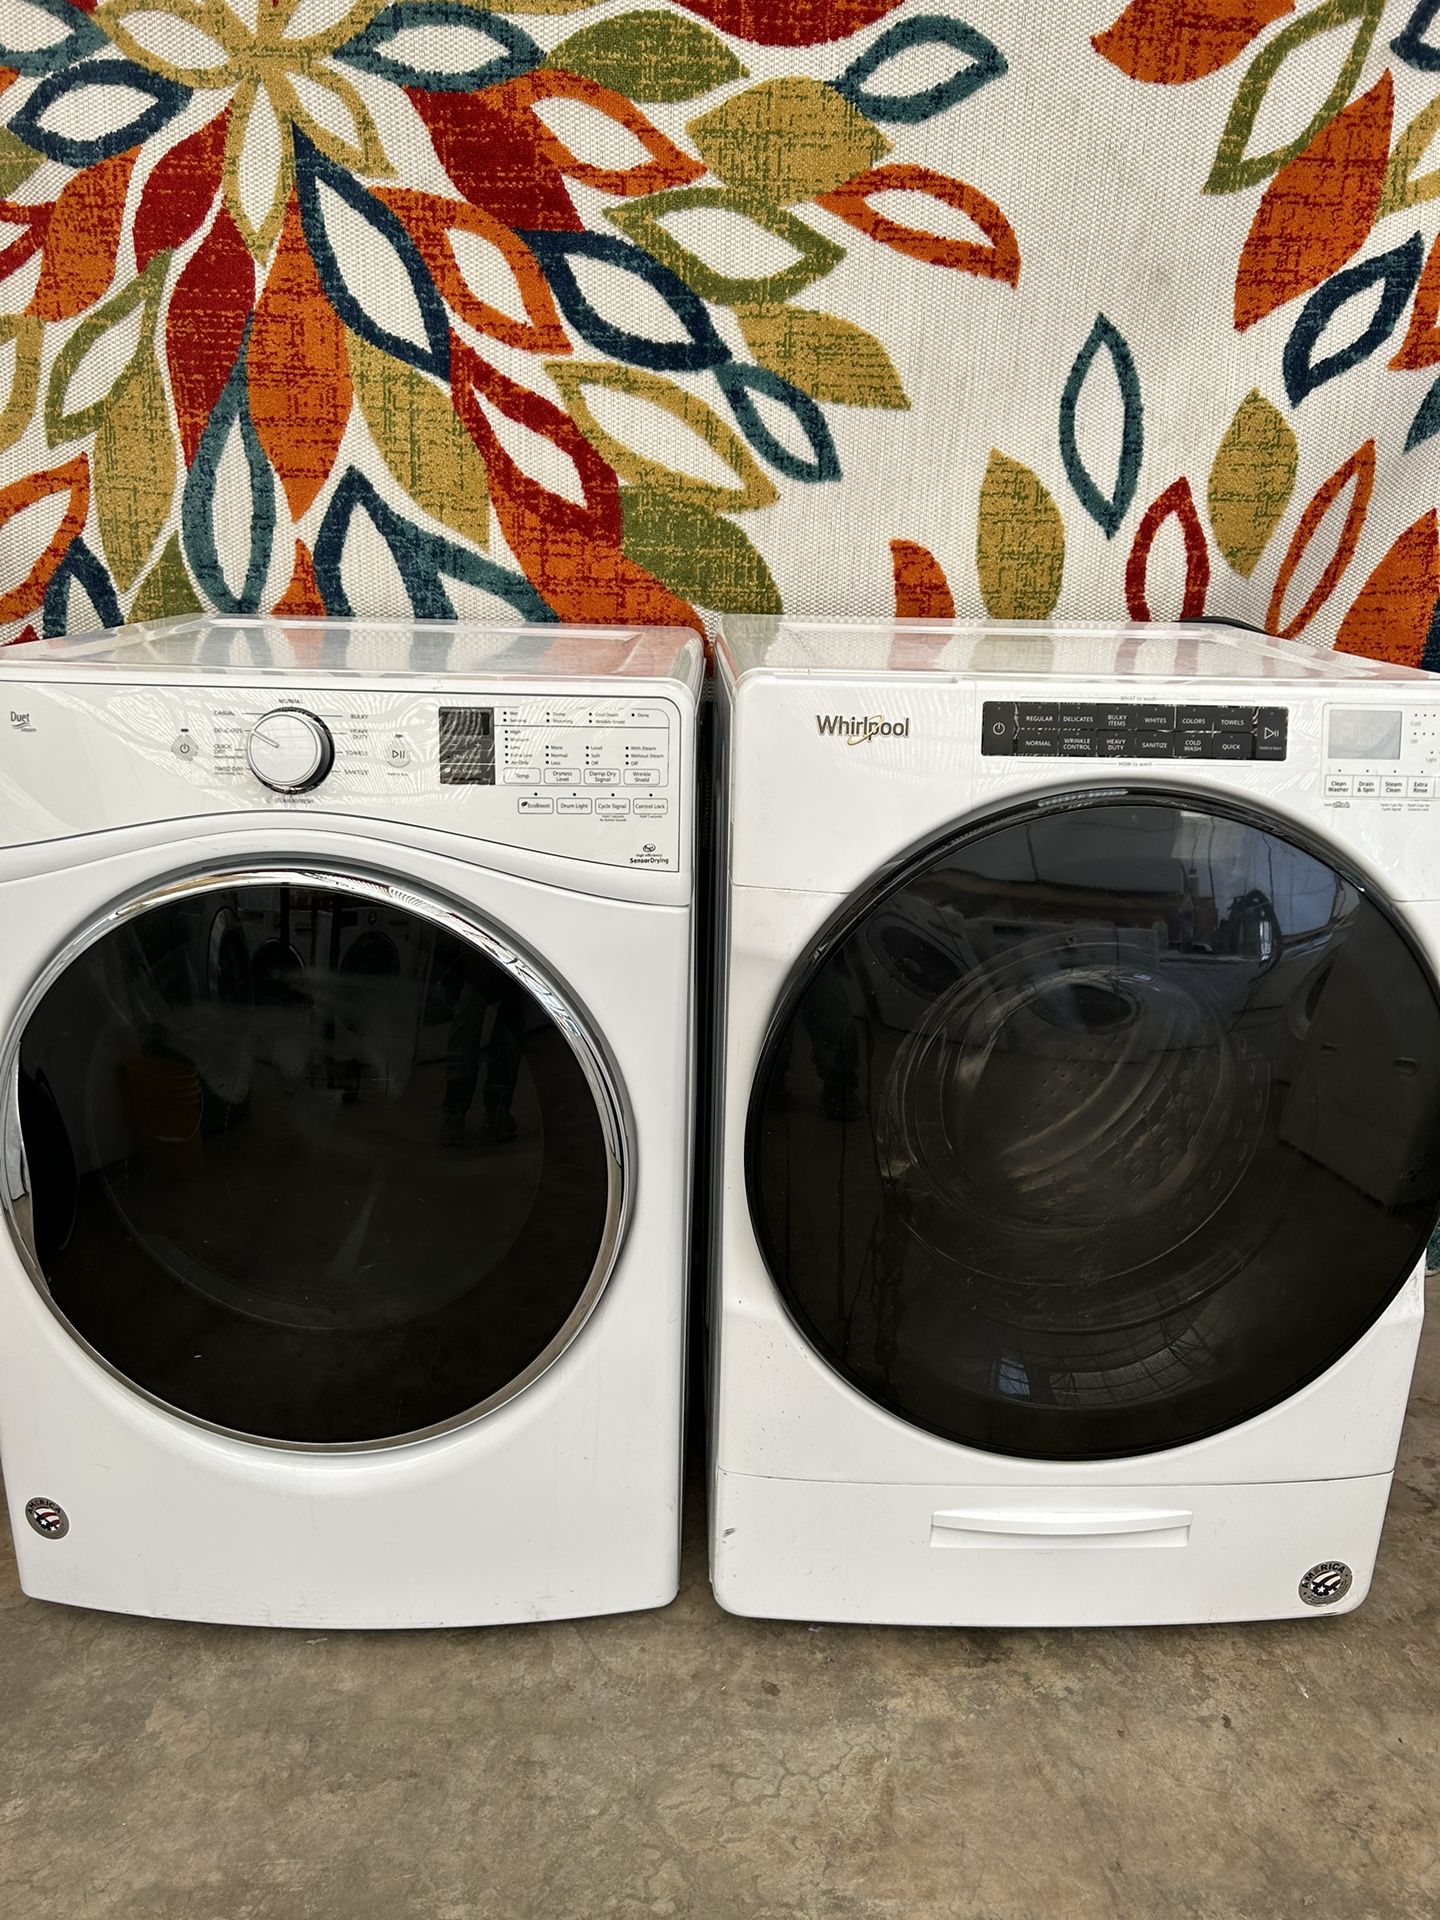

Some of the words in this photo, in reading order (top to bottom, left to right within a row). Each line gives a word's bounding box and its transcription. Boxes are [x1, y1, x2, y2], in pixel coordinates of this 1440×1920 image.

[10, 710, 30, 723] Duet
[1063, 715, 1094, 723] DELICATES
[816, 714, 910, 742] Whirlpool
[1142, 741, 1168, 749] SANITIZE
[1301, 1562, 1346, 1589] AMERICA
